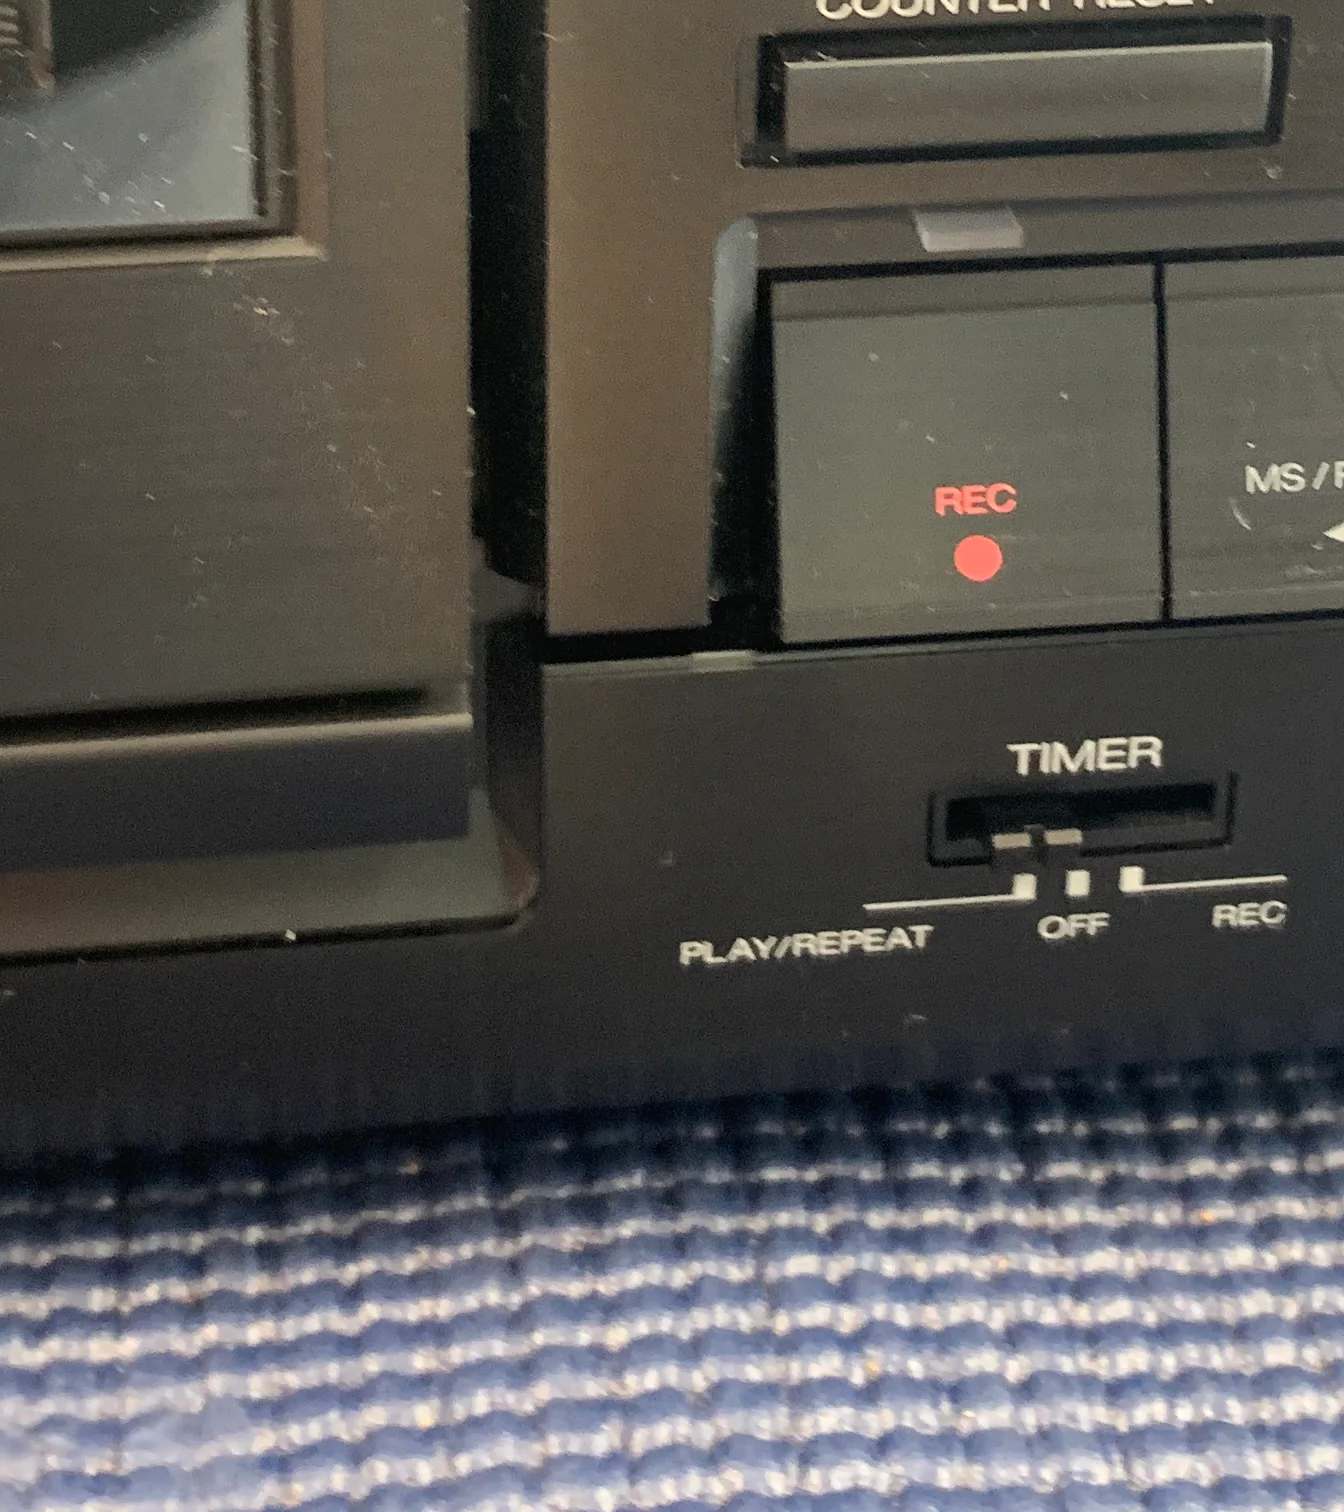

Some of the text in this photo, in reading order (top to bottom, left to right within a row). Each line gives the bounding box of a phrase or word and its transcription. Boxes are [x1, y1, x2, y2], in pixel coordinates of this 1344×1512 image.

[934, 482, 1018, 517] REC
[1006, 735, 1163, 776] TIMER
[1037, 912, 1111, 941] OFF
[1212, 900, 1288, 928] REC
[679, 924, 934, 966] PLAY/REPEAT
